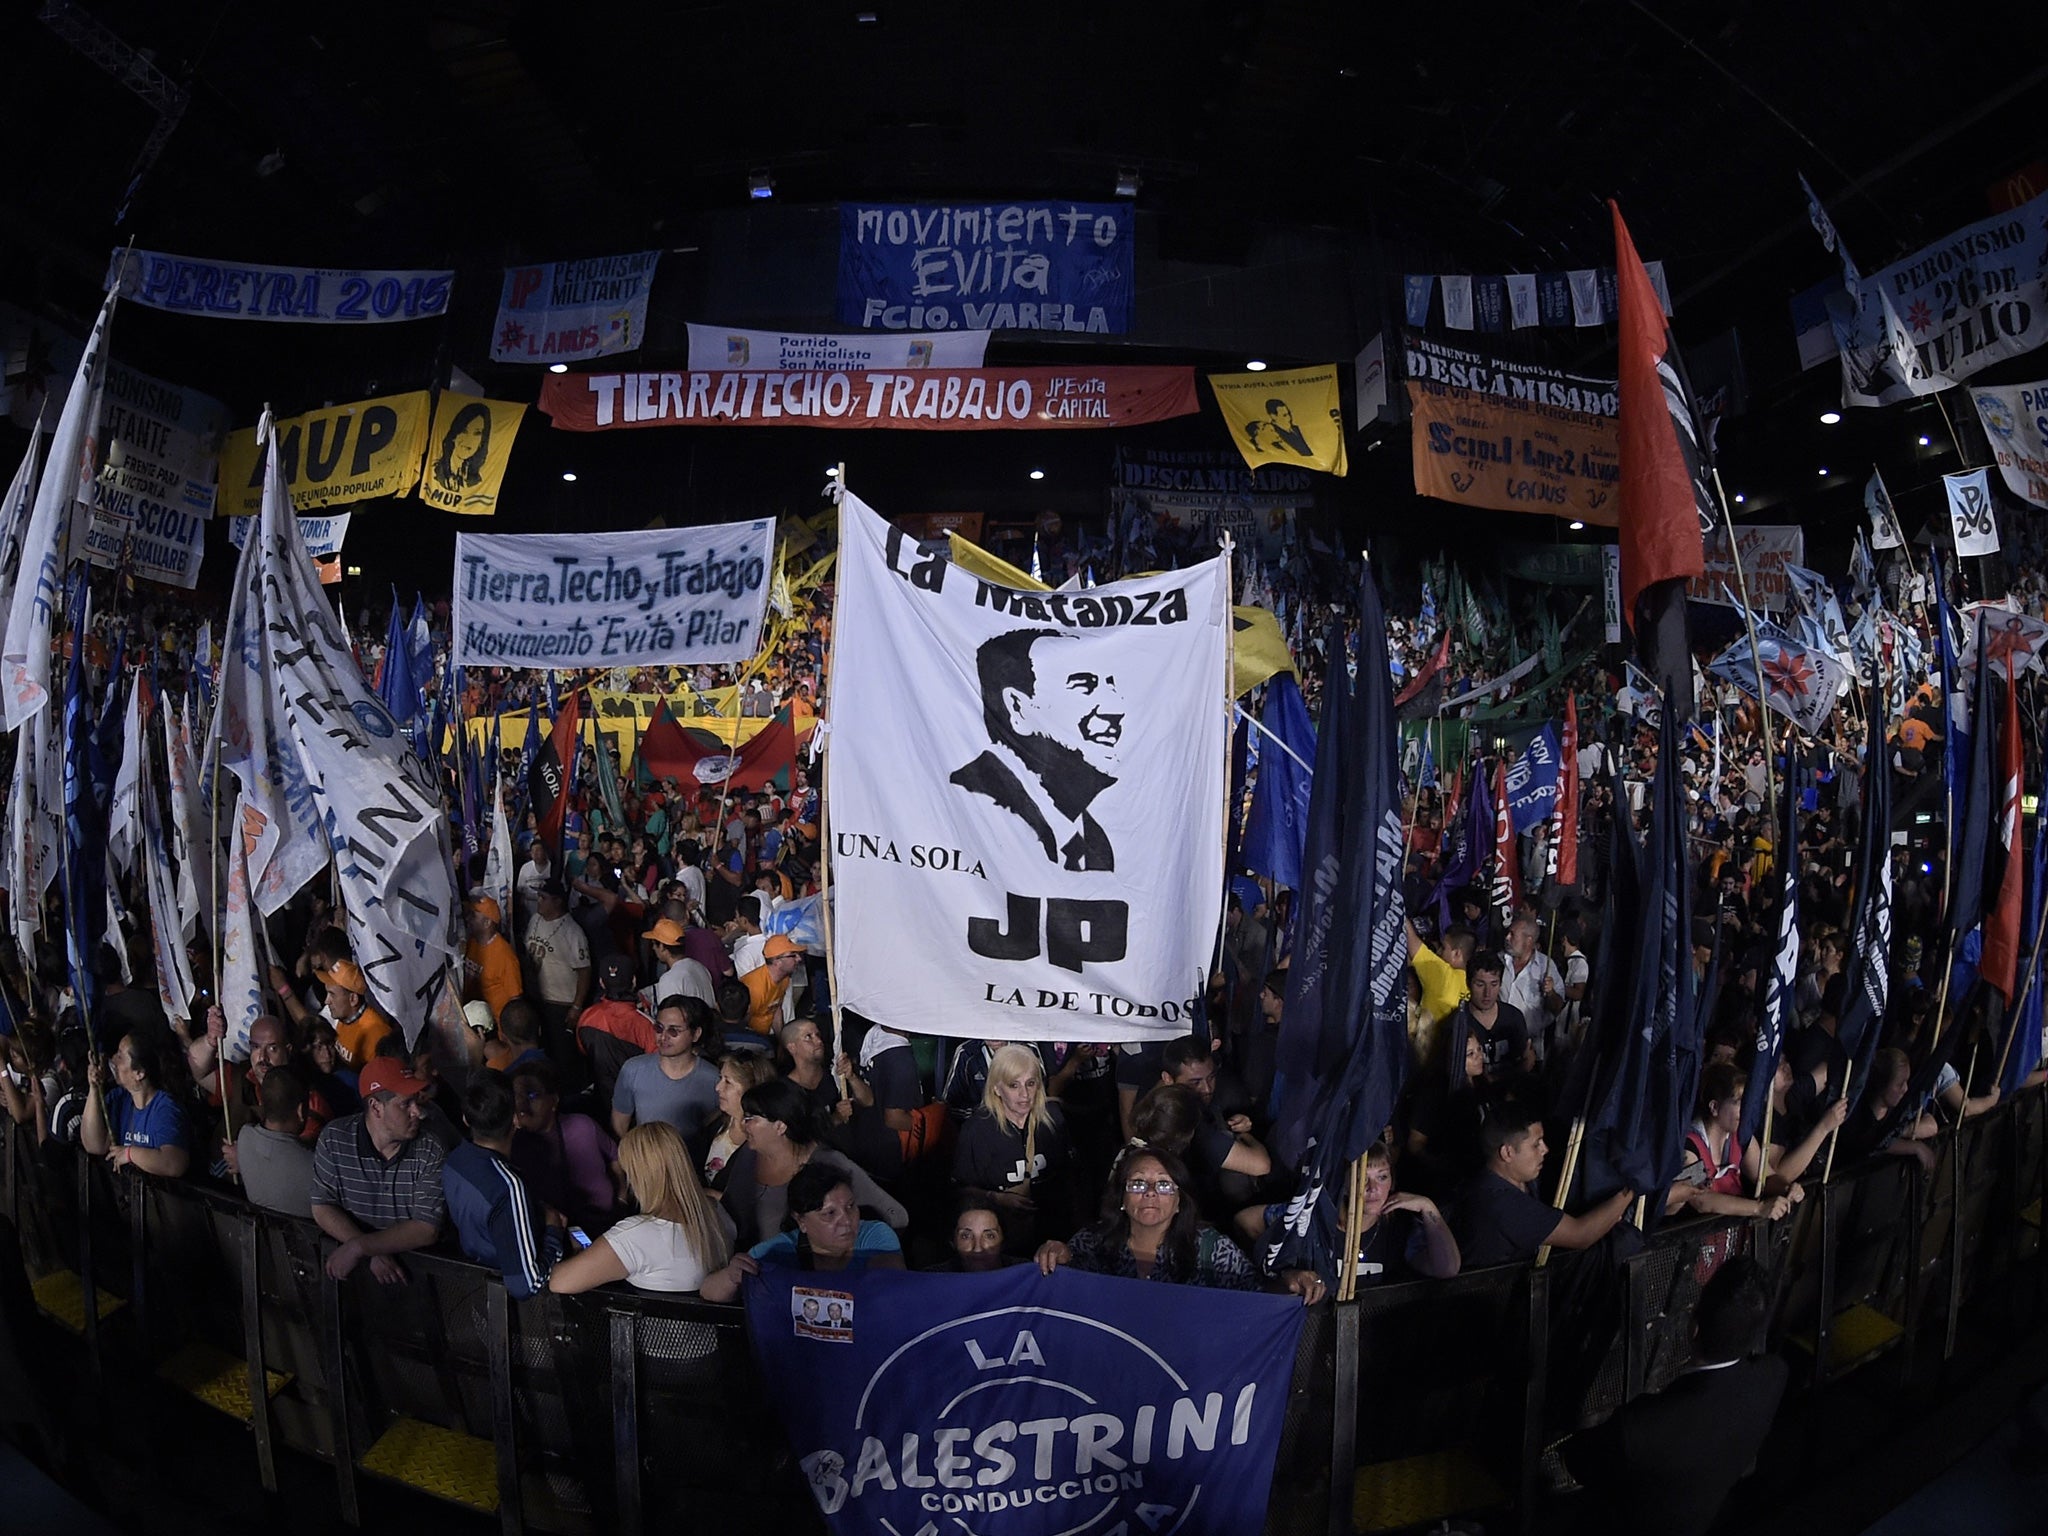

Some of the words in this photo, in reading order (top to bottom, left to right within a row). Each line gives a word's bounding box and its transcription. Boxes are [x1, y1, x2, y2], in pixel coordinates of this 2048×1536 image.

[1893, 221, 2026, 296] PERONISMO
[143, 256, 321, 318] PEREYRA
[335, 274, 451, 320] 2015
[1935, 268, 1979, 320] 26
[1983, 267, 2019, 296] DE
[962, 302, 1110, 335] VARELA
[779, 336, 838, 348] Partido
[779, 348, 872, 361] Justicialista
[1404, 335, 1482, 365] CRRIENTE
[779, 359, 808, 370] San
[1406, 350, 1619, 417] DESCAMISADO
[865, 373, 1033, 420] TRABAJO
[1045, 398, 1111, 419] CAPITAL
[105, 468, 119, 484] LA
[307, 485, 342, 503] UNIDAD
[343, 477, 386, 498] POPULAR
[432, 488, 463, 508] MUP
[87, 527, 123, 555] ariano
[136, 498, 199, 546] SCIOLI
[553, 555, 640, 604] Techo
[657, 545, 764, 599] Trabajo
[885, 523, 949, 596] La
[463, 615, 593, 659] Movimiento
[685, 609, 750, 648] Pilar
[836, 832, 902, 864] UNA
[910, 845, 989, 880] SOLA
[983, 982, 1035, 1010] LA
[1037, 989, 1080, 1013] DE
[1089, 993, 1194, 1023] TODOS
[964, 1330, 1048, 1371] LA
[799, 1382, 1258, 1515] BALESTRINI
[920, 1470, 1144, 1514] CONDUCCION
